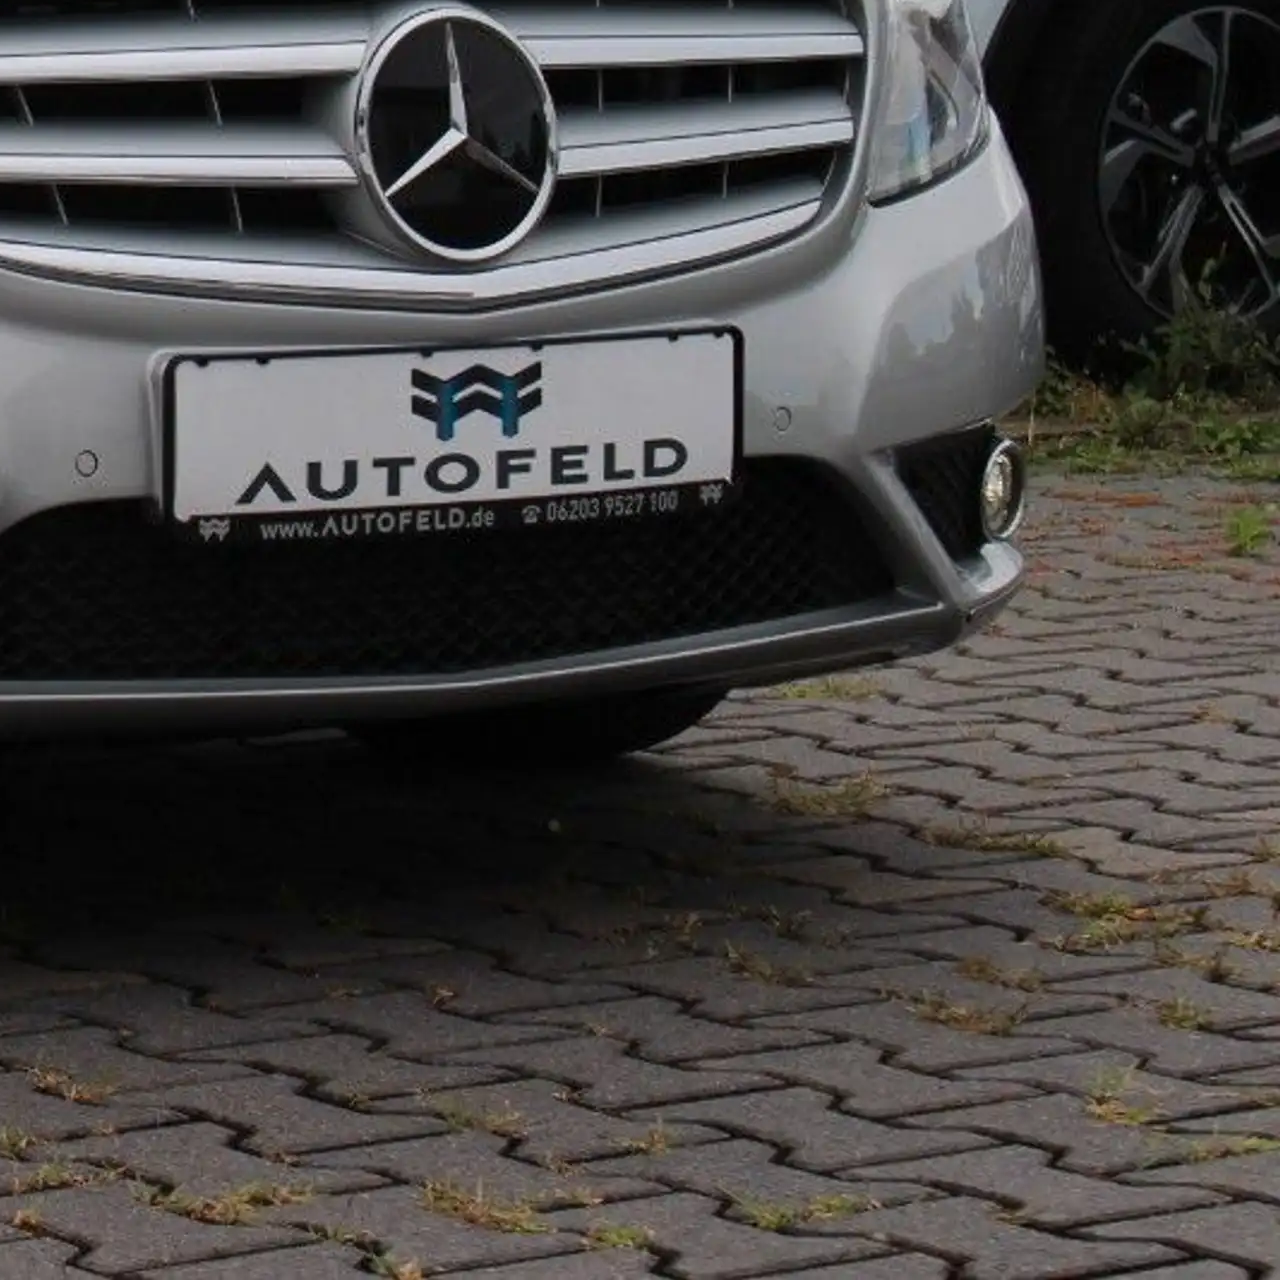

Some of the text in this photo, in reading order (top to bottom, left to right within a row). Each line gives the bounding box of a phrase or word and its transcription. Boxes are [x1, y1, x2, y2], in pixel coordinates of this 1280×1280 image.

[235, 437, 689, 505] AUTOFELD
[260, 490, 679, 540] www.AUTOFELD.de 06203 9527 100
